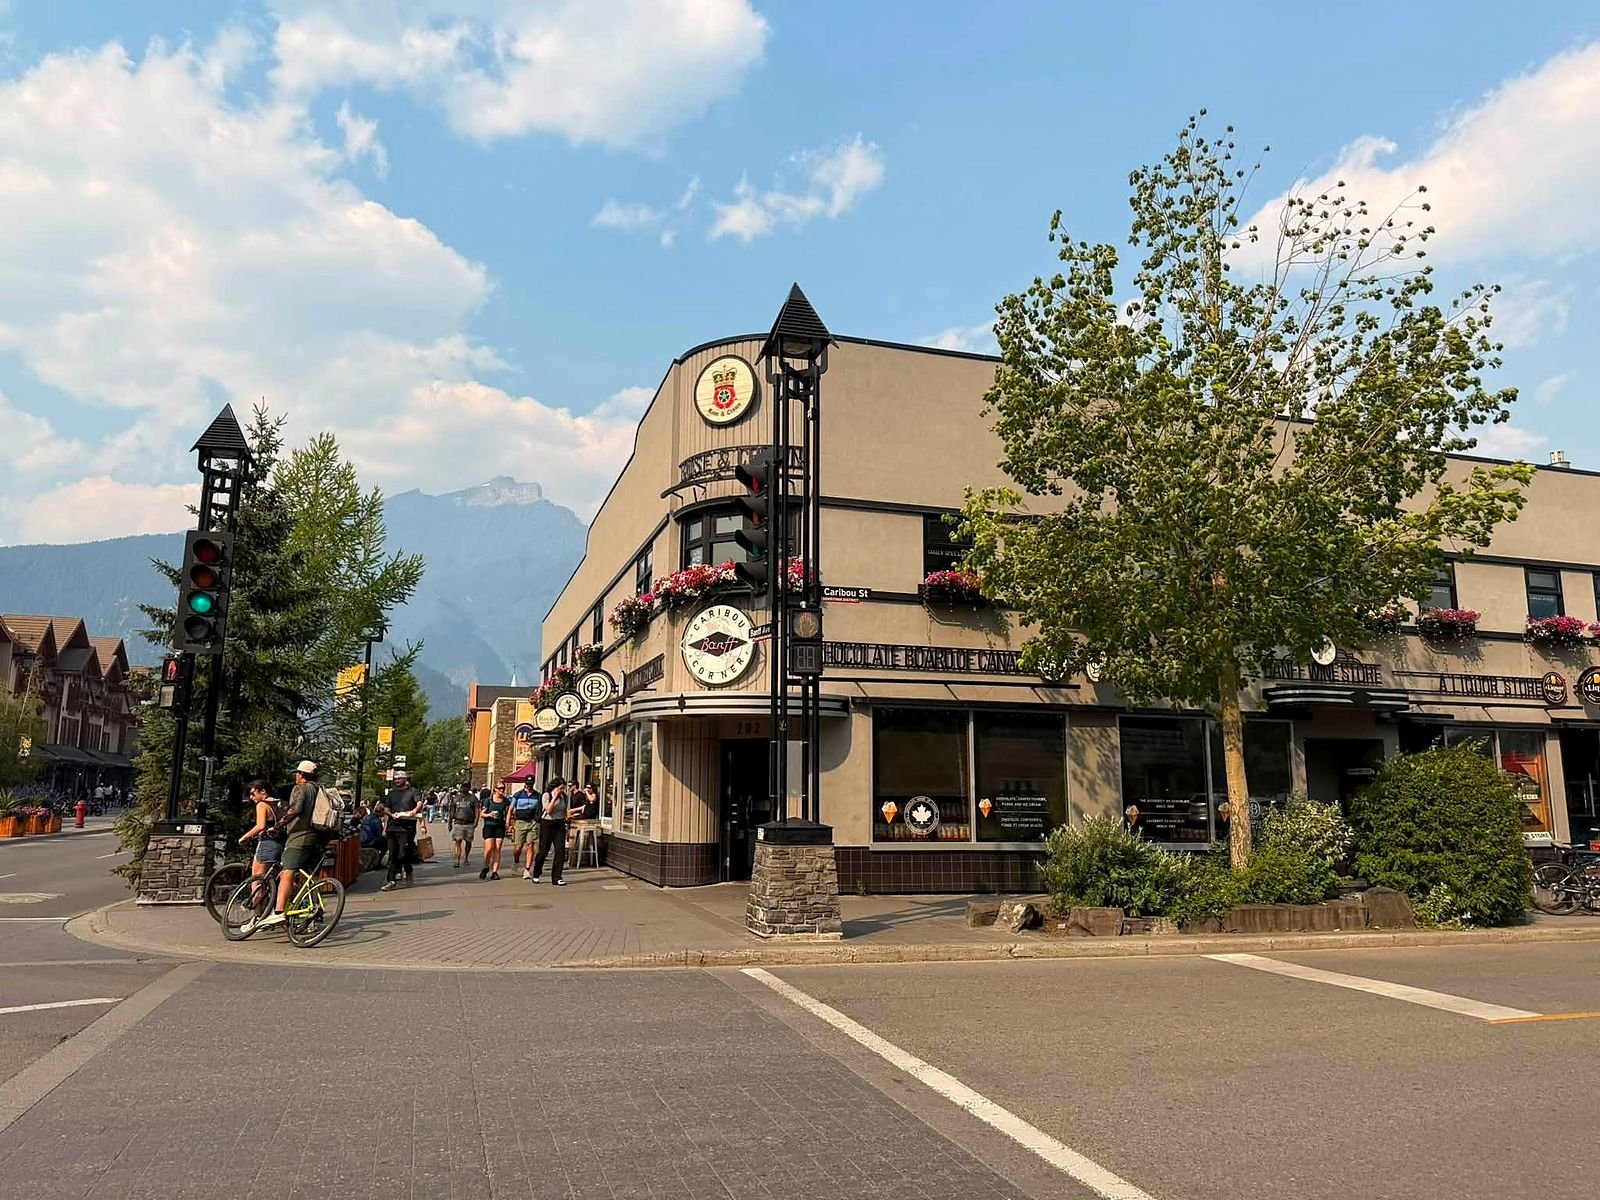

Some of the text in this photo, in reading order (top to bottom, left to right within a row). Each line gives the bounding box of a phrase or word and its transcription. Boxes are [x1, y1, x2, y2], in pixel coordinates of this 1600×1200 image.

[823, 587, 869, 598] Caribou St
[693, 608, 746, 631] CARIBOU
[700, 636, 739, 655] Banff
[824, 643, 900, 667] HOCOLATE
[692, 657, 745, 680] CORNER
[1452, 676, 1498, 696] LIQUOR
[1504, 679, 1544, 698] STORE
